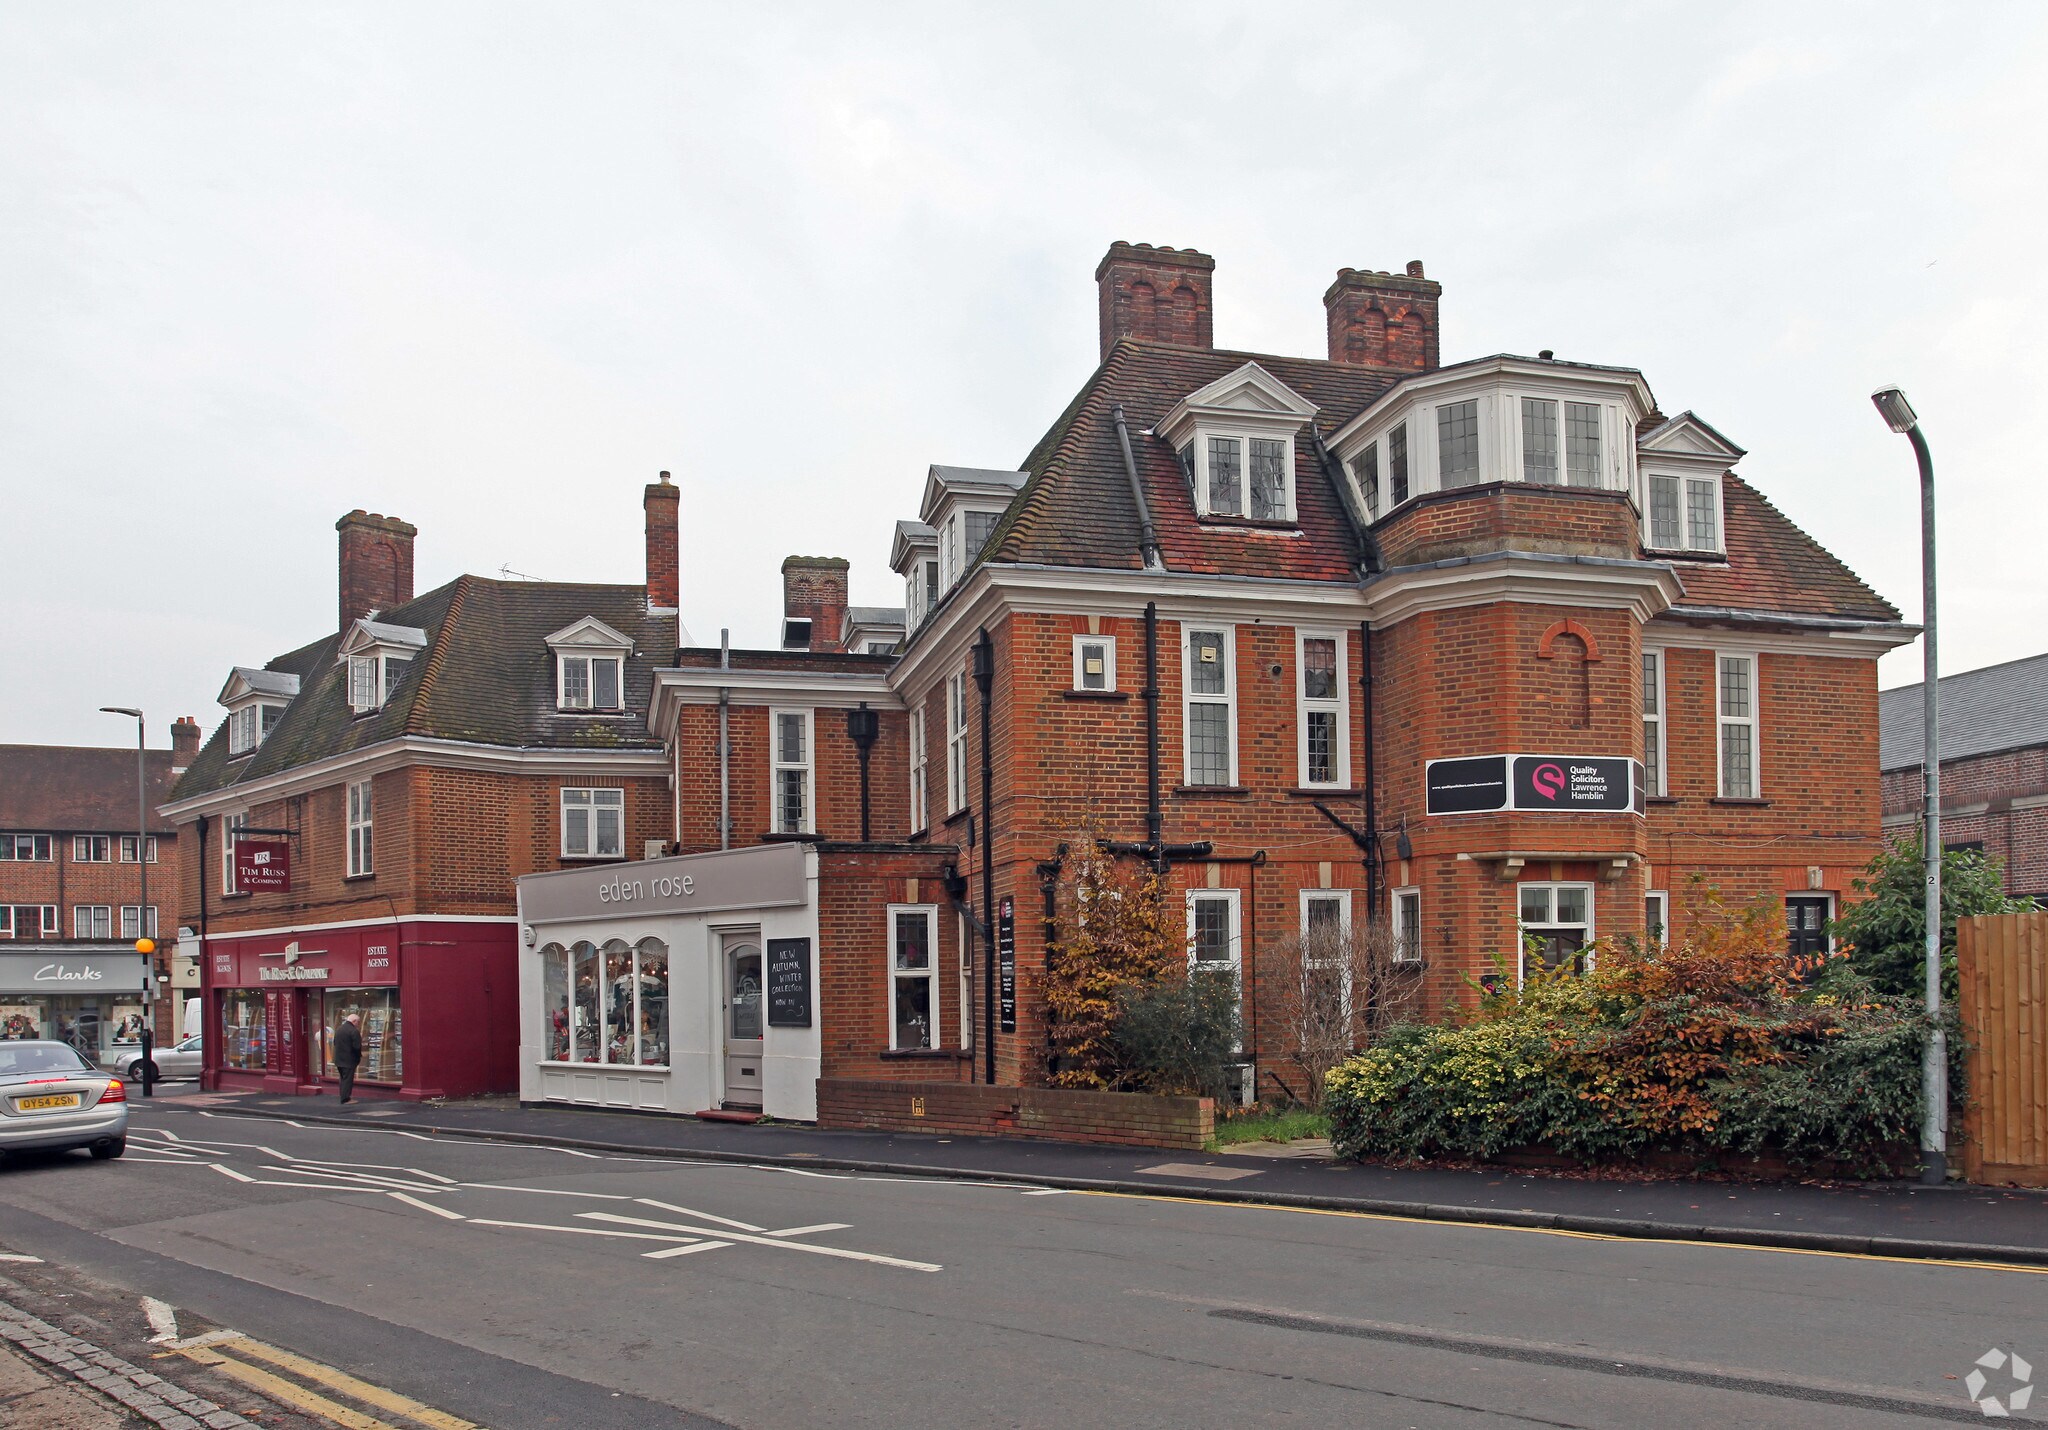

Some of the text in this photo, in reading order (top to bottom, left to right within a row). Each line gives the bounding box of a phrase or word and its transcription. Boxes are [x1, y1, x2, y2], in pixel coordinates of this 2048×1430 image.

[1570, 766, 1597, 776] Quality
[1571, 775, 1605, 783] Solicitors
[1571, 783, 1608, 791] Lawrence
[1571, 792, 1604, 800] Hamblin
[240, 867, 286, 876] TIM RUSS
[1928, 876, 1935, 885] 2
[599, 874, 695, 903] eden rose
[367, 946, 388, 956] ESTATE
[779, 949, 796, 961] NEW
[367, 958, 389, 968] AGENTS
[33, 963, 103, 981] Clarks
